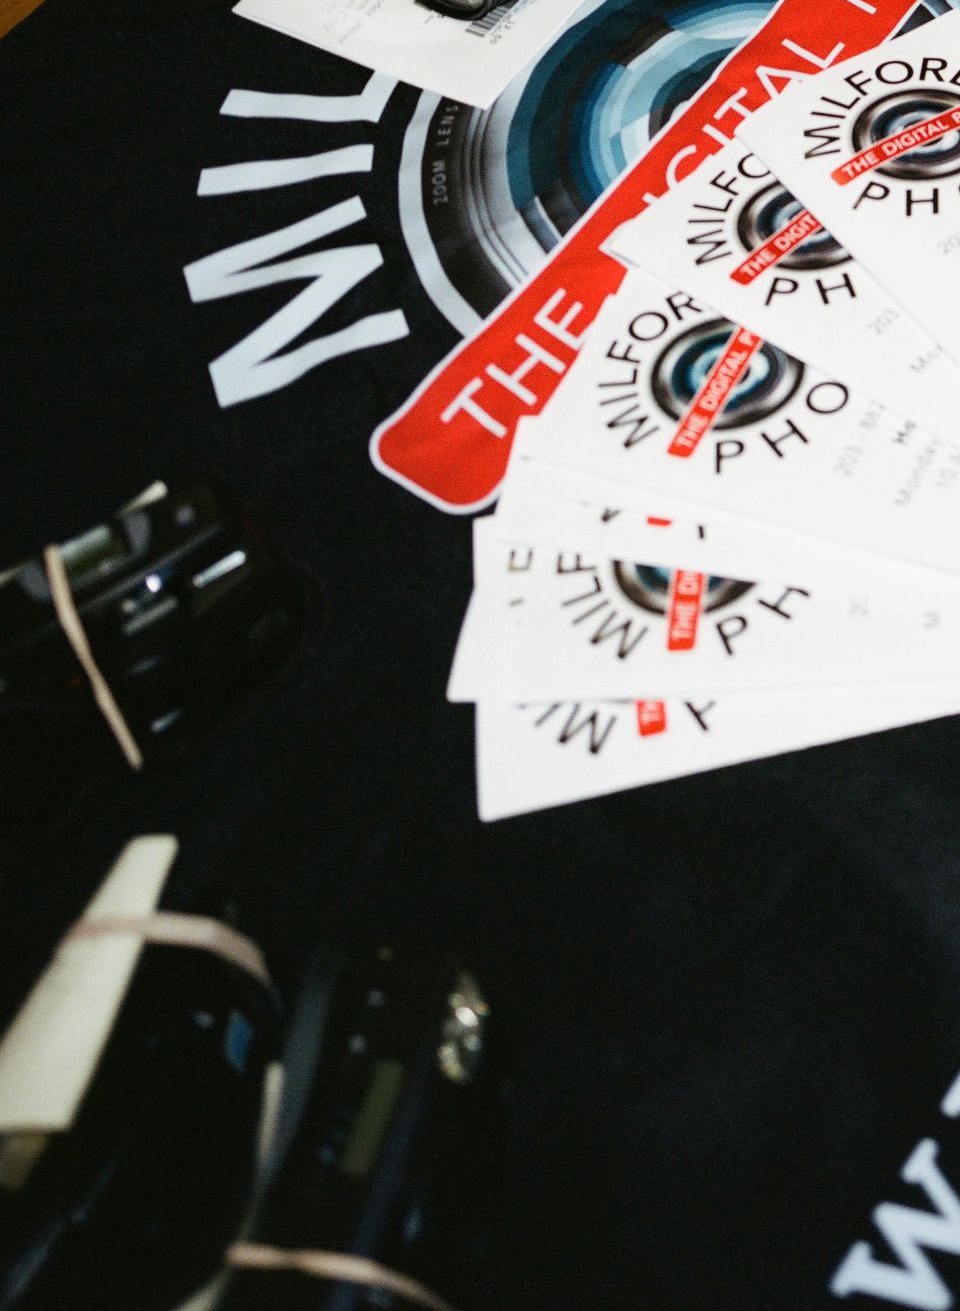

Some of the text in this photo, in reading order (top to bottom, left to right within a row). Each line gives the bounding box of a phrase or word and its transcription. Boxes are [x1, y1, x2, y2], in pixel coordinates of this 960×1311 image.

[432, 160, 448, 204] ZOOM
[841, 154, 881, 178] THE
[881, 122, 950, 157] DIGITAL
[686, 153, 772, 265] MILFO
[740, 212, 817, 279] THE DIGIT
[440, 288, 585, 439] THE
[598, 291, 703, 449] MILFOR
[715, 381, 850, 474] PHO
